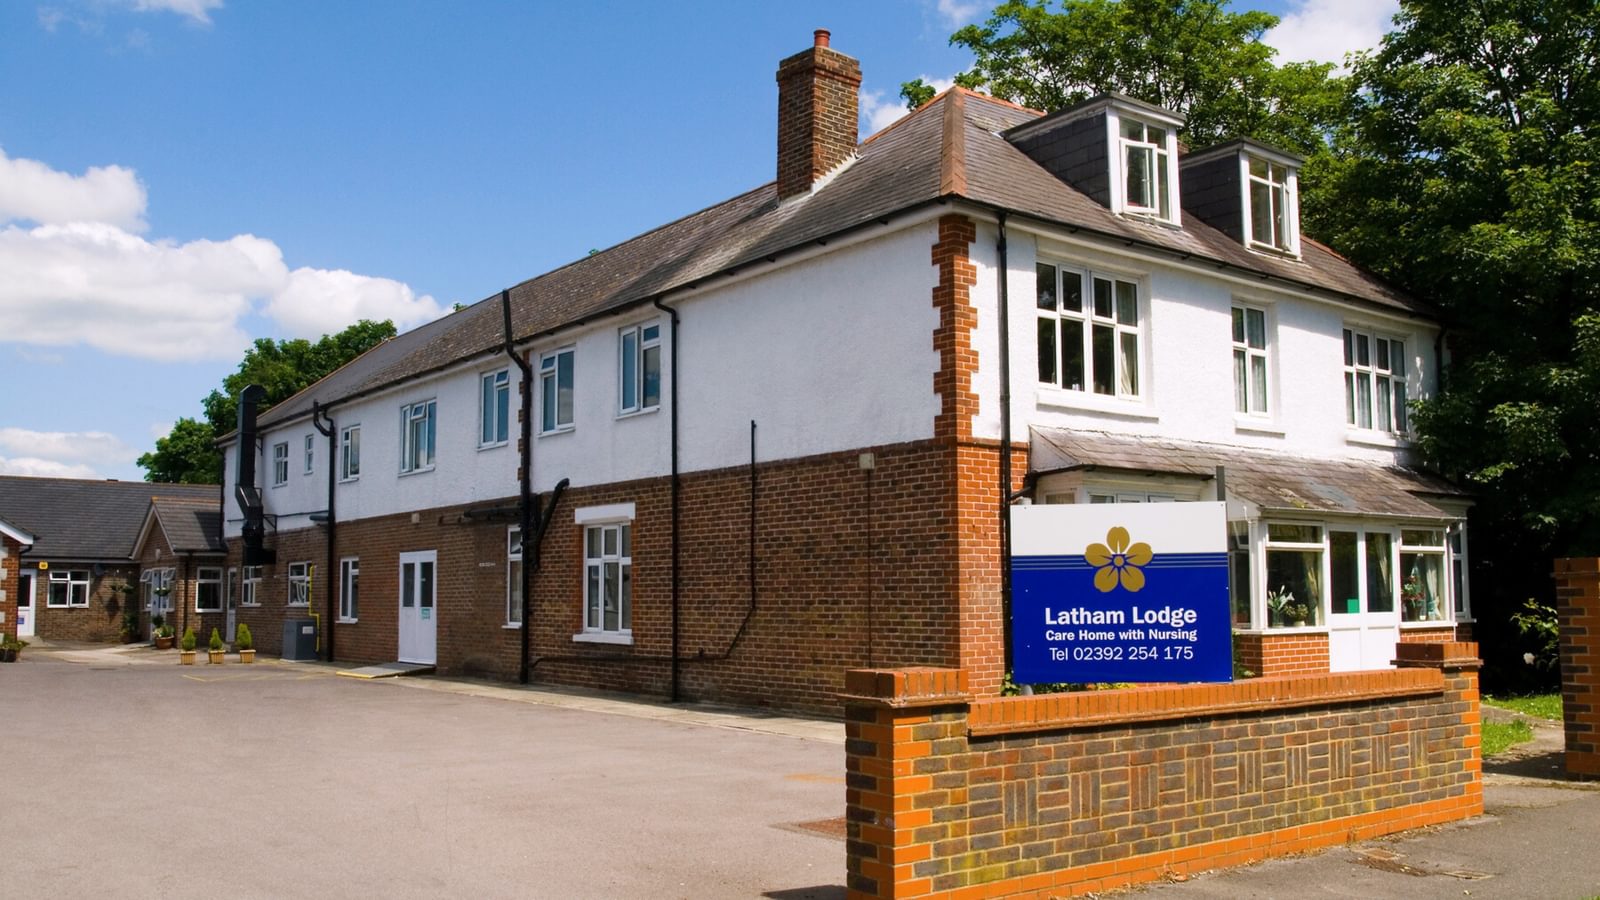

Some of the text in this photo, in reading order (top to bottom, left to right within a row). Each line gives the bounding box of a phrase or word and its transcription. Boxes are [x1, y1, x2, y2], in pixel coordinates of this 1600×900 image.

[1045, 606, 1197, 627] Latham Lodge
[1045, 629, 1198, 642] Care Home with Nursing
[1049, 646, 1194, 661] Tel 02392 254 175
